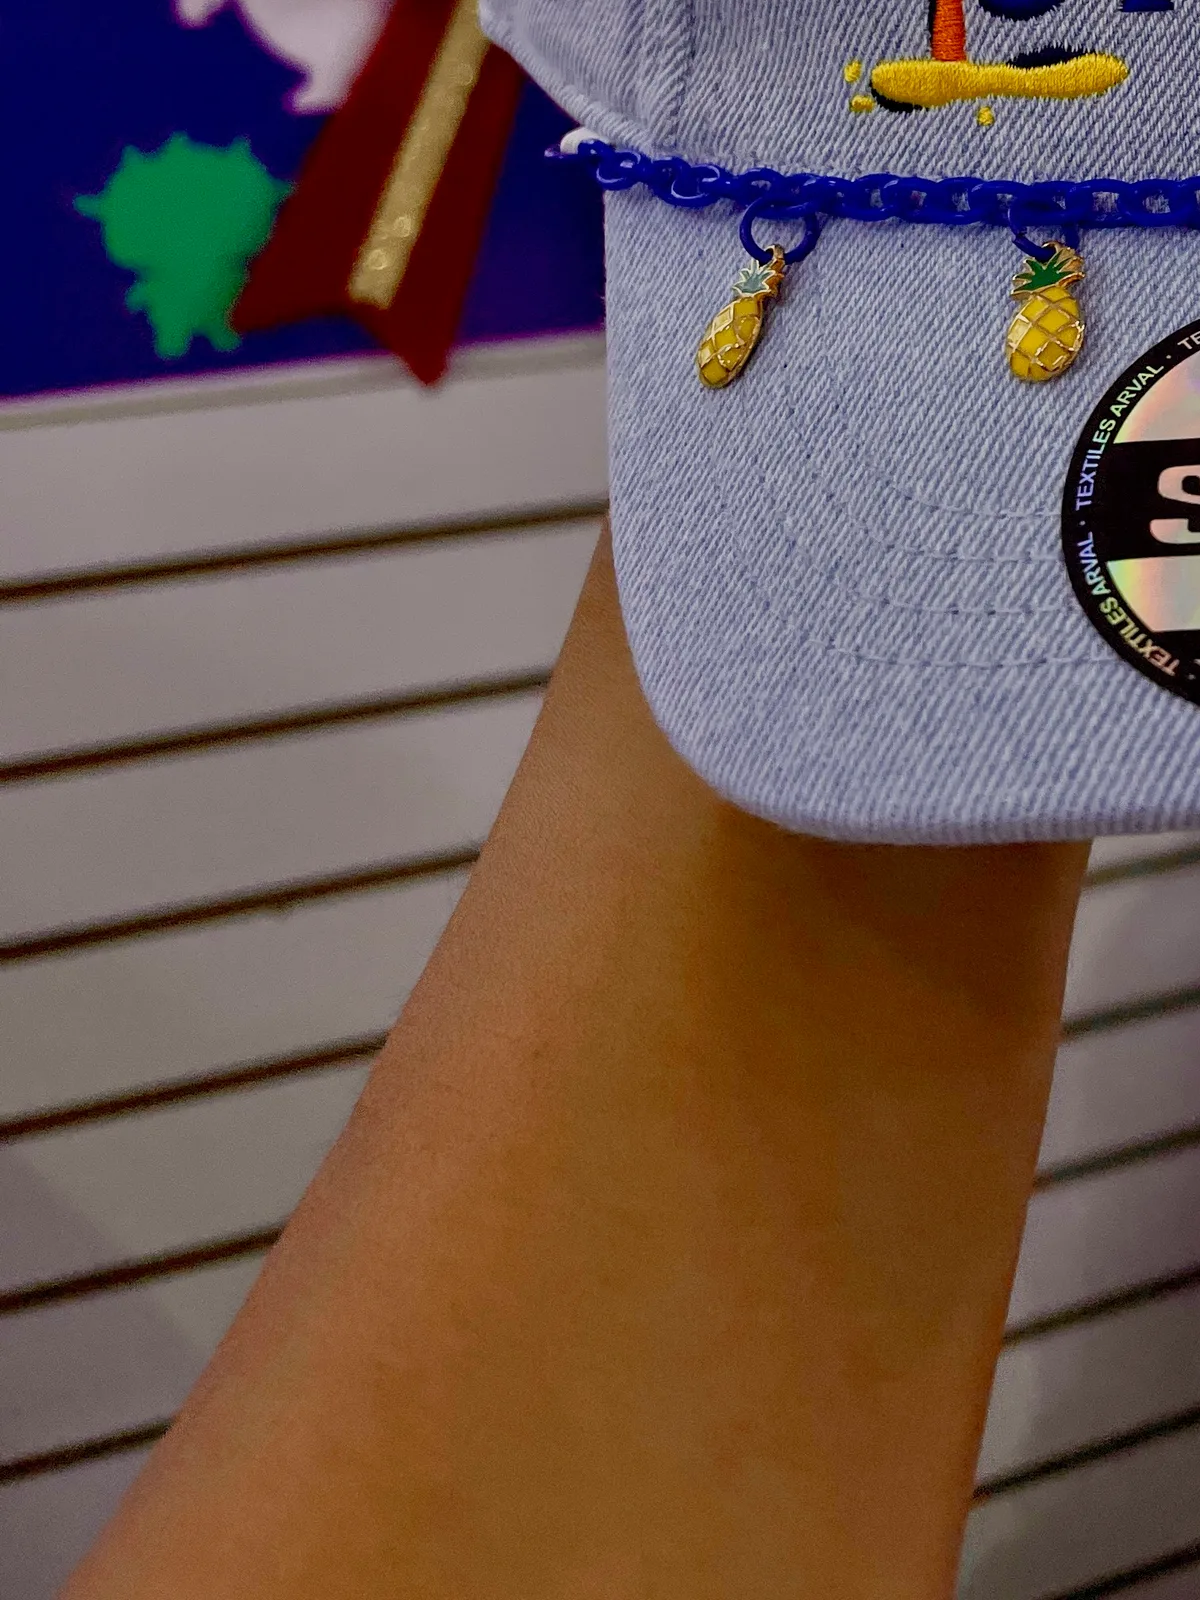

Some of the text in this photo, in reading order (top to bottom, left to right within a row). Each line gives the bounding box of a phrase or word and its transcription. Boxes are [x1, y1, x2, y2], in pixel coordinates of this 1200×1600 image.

[1076, 363, 1165, 511] TEXTILES ARVAL
[1077, 531, 1182, 677] TEXTILES ARVAL
